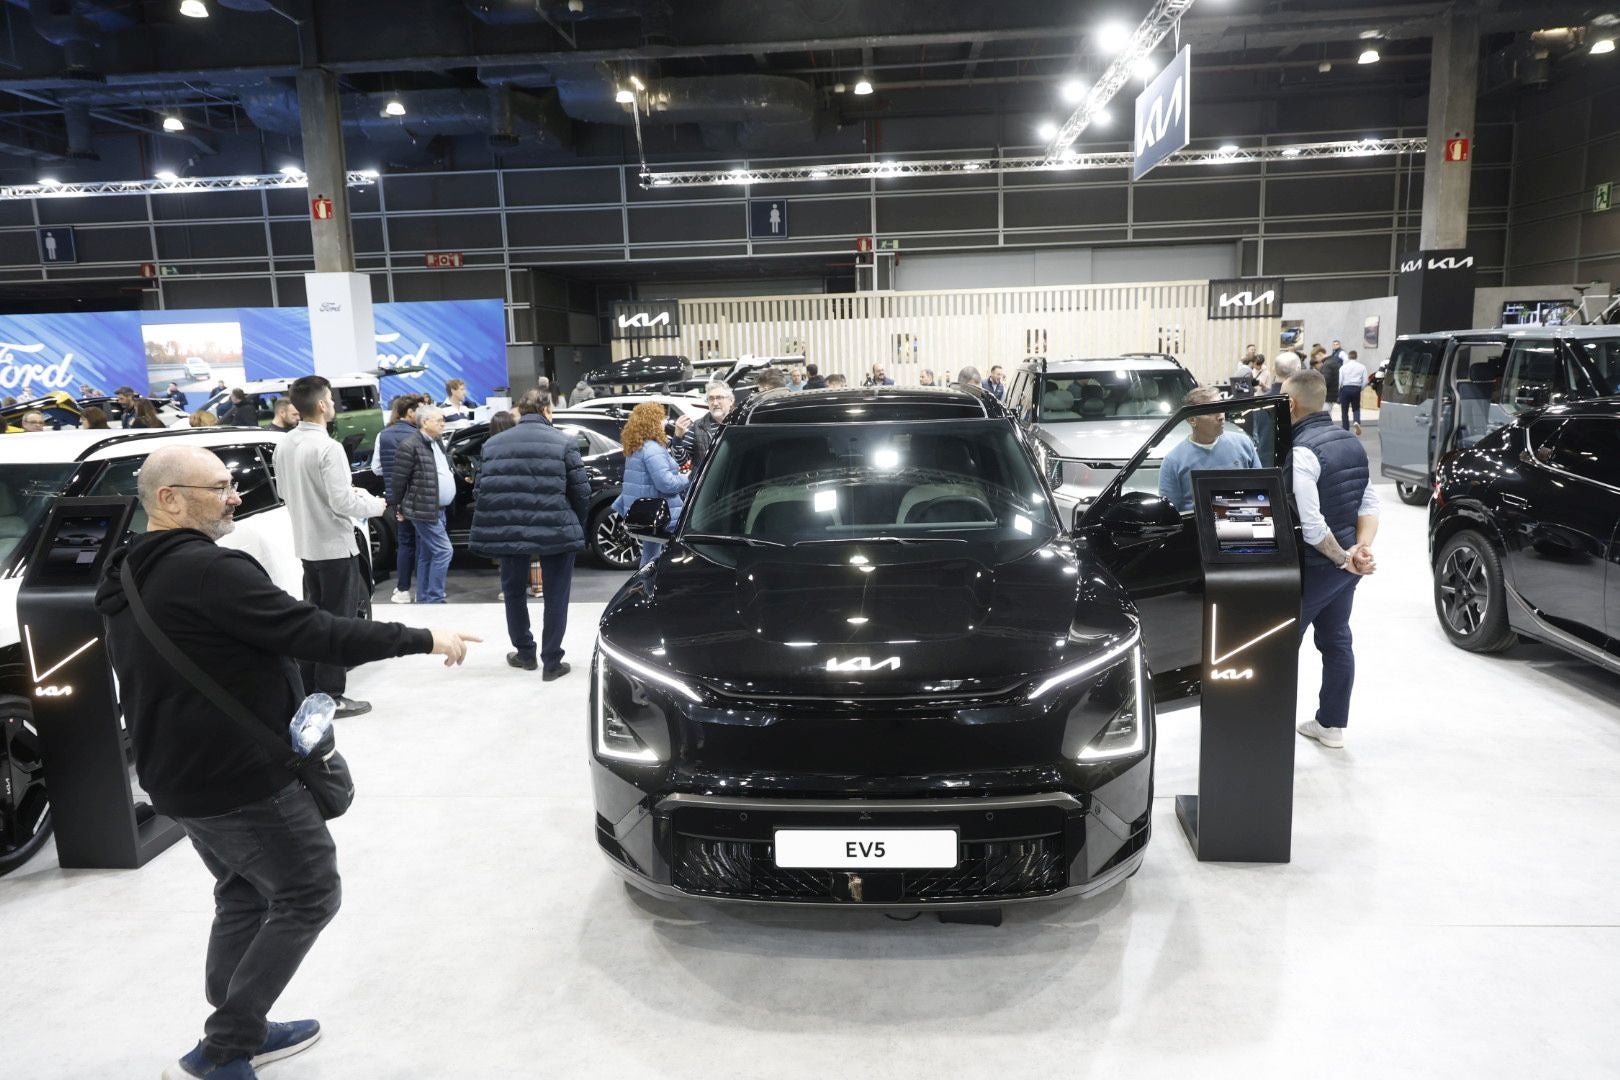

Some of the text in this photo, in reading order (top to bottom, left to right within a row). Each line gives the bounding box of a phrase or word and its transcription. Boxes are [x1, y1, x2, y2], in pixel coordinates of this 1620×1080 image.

[1135, 76, 1182, 157] KIA
[1401, 259, 1422, 272] KIA
[1428, 256, 1473, 269] KIA
[1220, 290, 1274, 306] KIA
[320, 302, 341, 312] Ford
[618, 312, 669, 327] KIA
[826, 657, 900, 670] KIA
[1211, 669, 1252, 679] KIA
[36, 686, 72, 696] KIA
[846, 842, 886, 857] EV5
